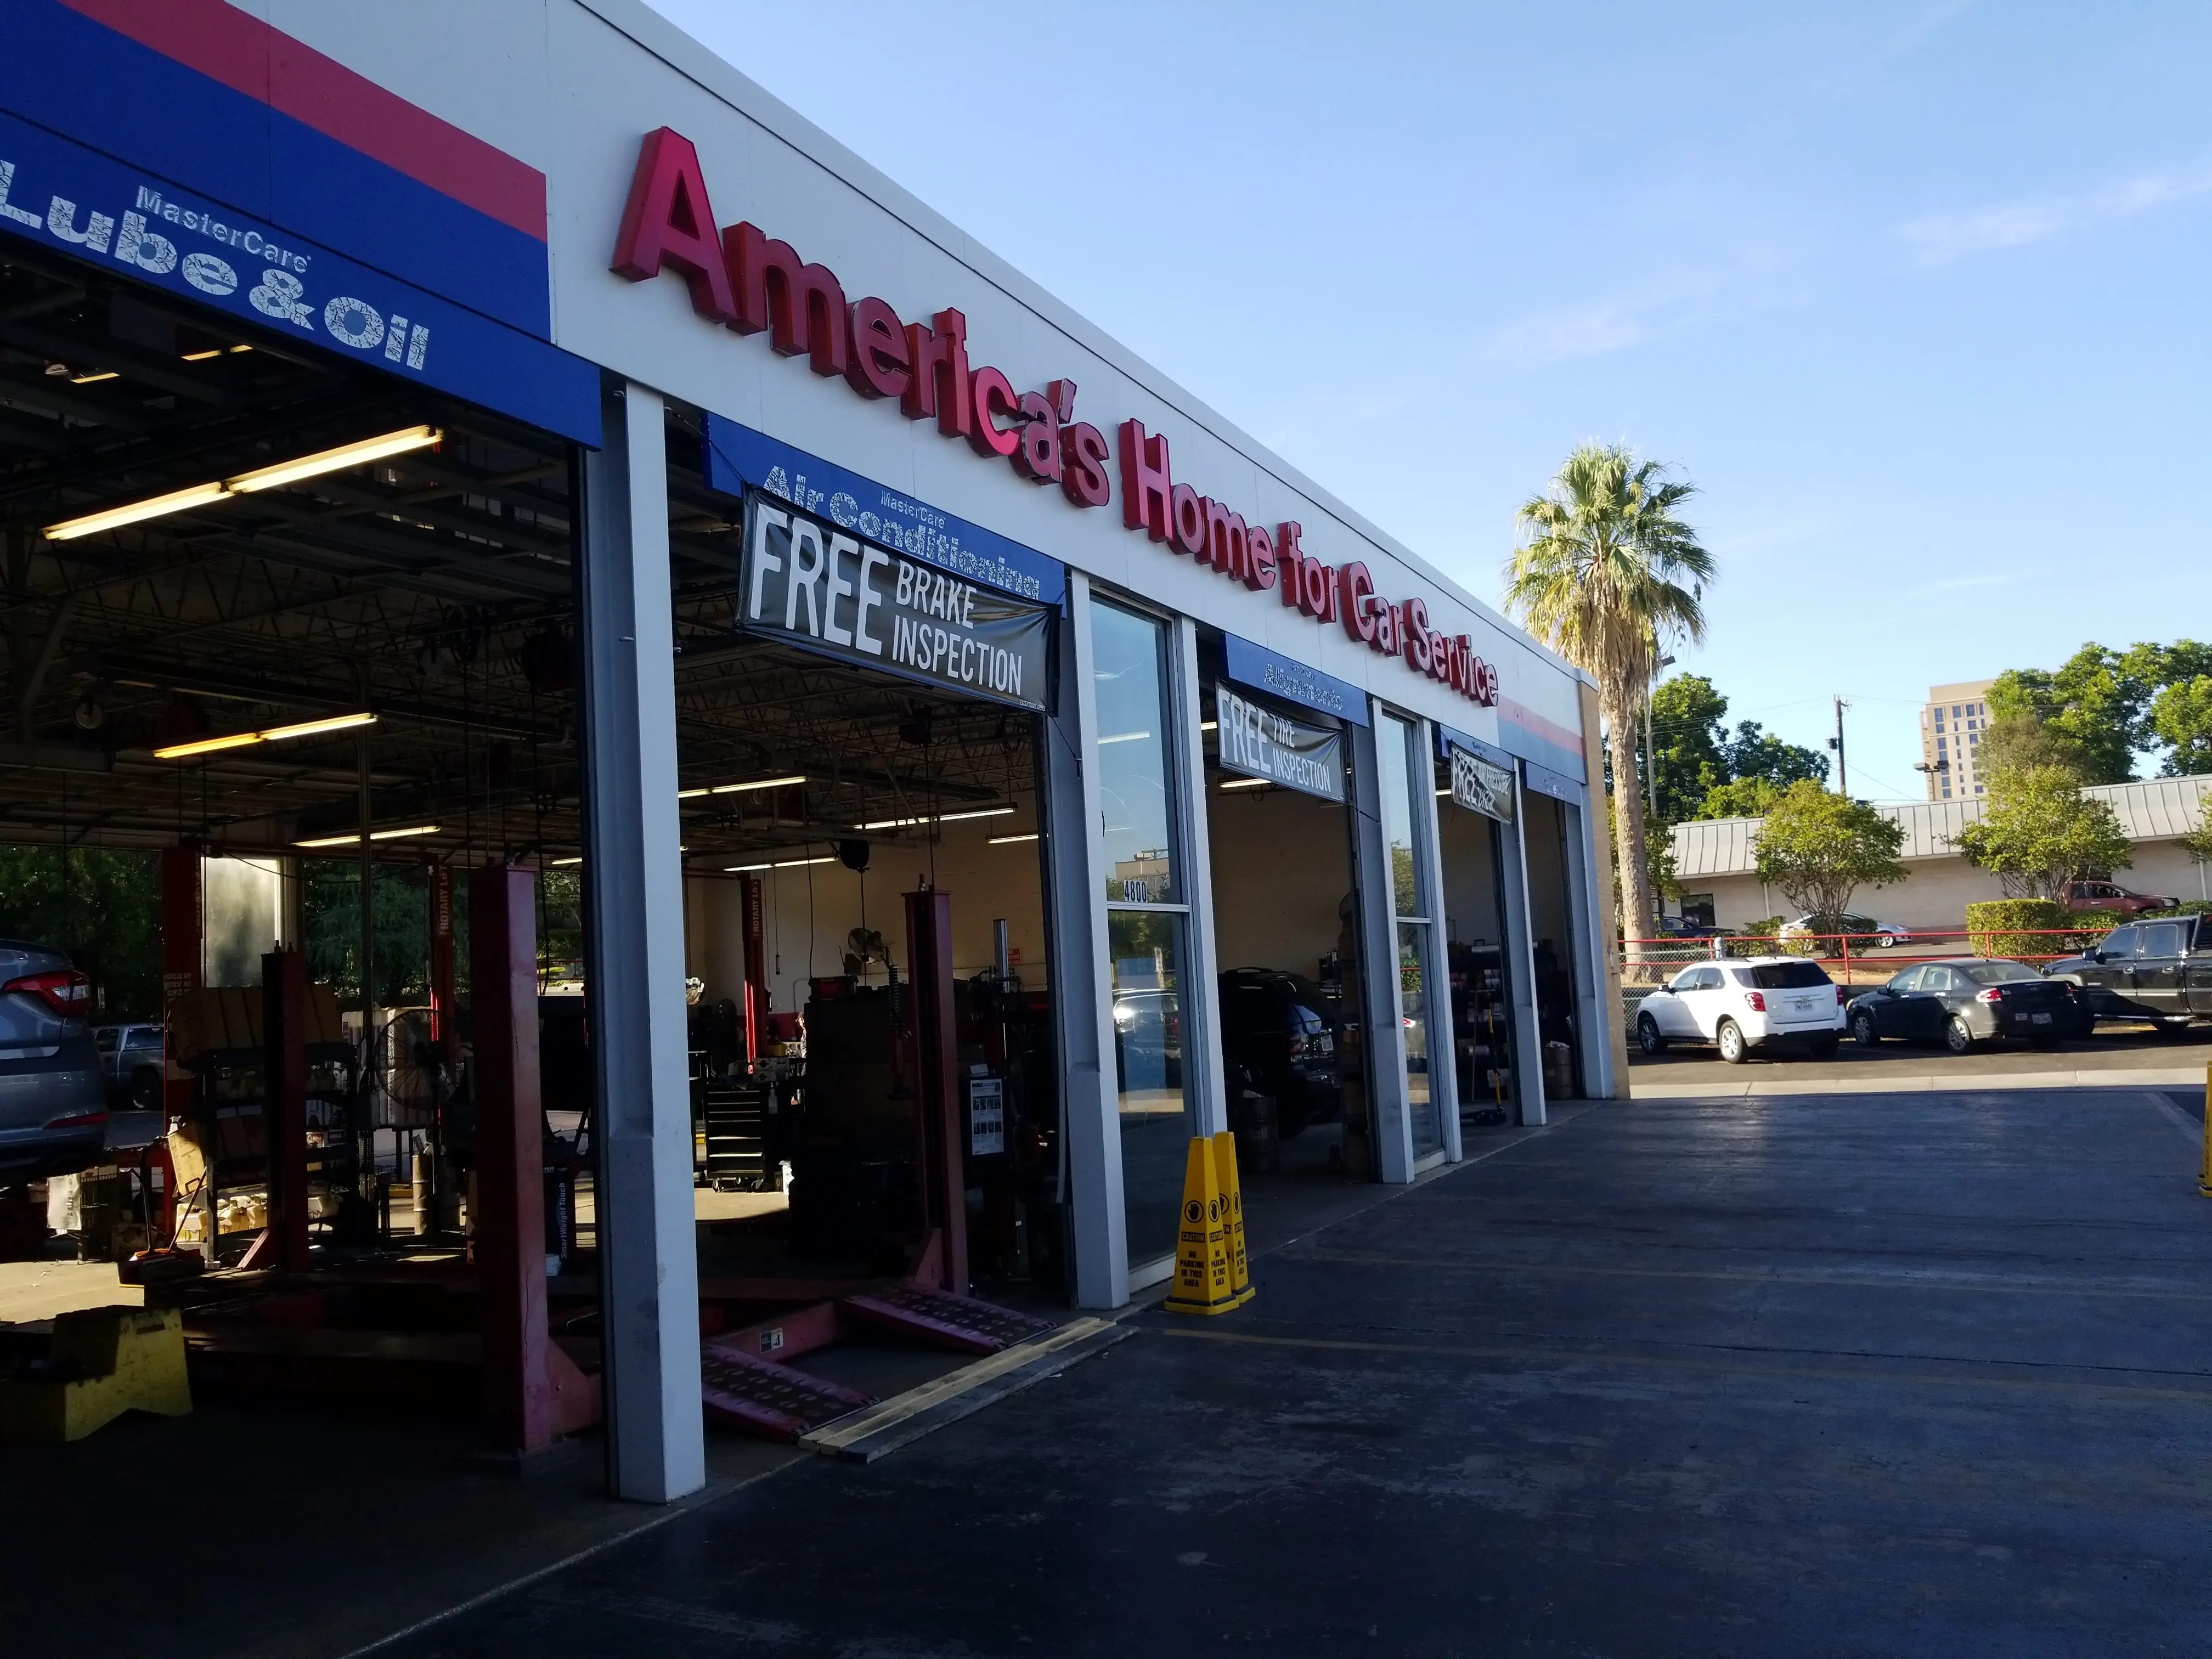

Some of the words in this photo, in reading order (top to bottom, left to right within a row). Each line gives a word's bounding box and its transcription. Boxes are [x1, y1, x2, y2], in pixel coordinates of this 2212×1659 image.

[136, 185, 309, 274] MasterCare
[0, 160, 238, 295] Lube
[249, 269, 315, 331] &
[324, 296, 430, 370] Oil
[609, 126, 1110, 508] America's
[1118, 418, 1276, 591] Home
[1277, 521, 1339, 624] for
[1340, 561, 1404, 657] Car
[1404, 597, 1499, 707] Service
[763, 465, 824, 514] Air
[881, 490, 946, 529] MasterCare
[750, 504, 889, 655] FREE
[895, 560, 977, 629] BRAKE
[892, 614, 1022, 696] INSPECTION
[1218, 688, 1271, 774] FREE
[1271, 714, 1295, 748] TIRE
[1273, 748, 1331, 792] INSPECTION
[439, 865, 448, 885] LIFT
[1125, 880, 1147, 902] 4800
[439, 889, 449, 929] ROTARY
[1182, 1232, 1204, 1242] CAUTION
[1210, 1231, 1223, 1242] CAUTION
[1180, 1260, 1204, 1268] PARKING
[1189, 1269, 1202, 1278] THIS
[1211, 1258, 1225, 1268] PARKING
[1216, 1277, 1224, 1286] AREA
[1184, 1279, 1199, 1287] AREA
